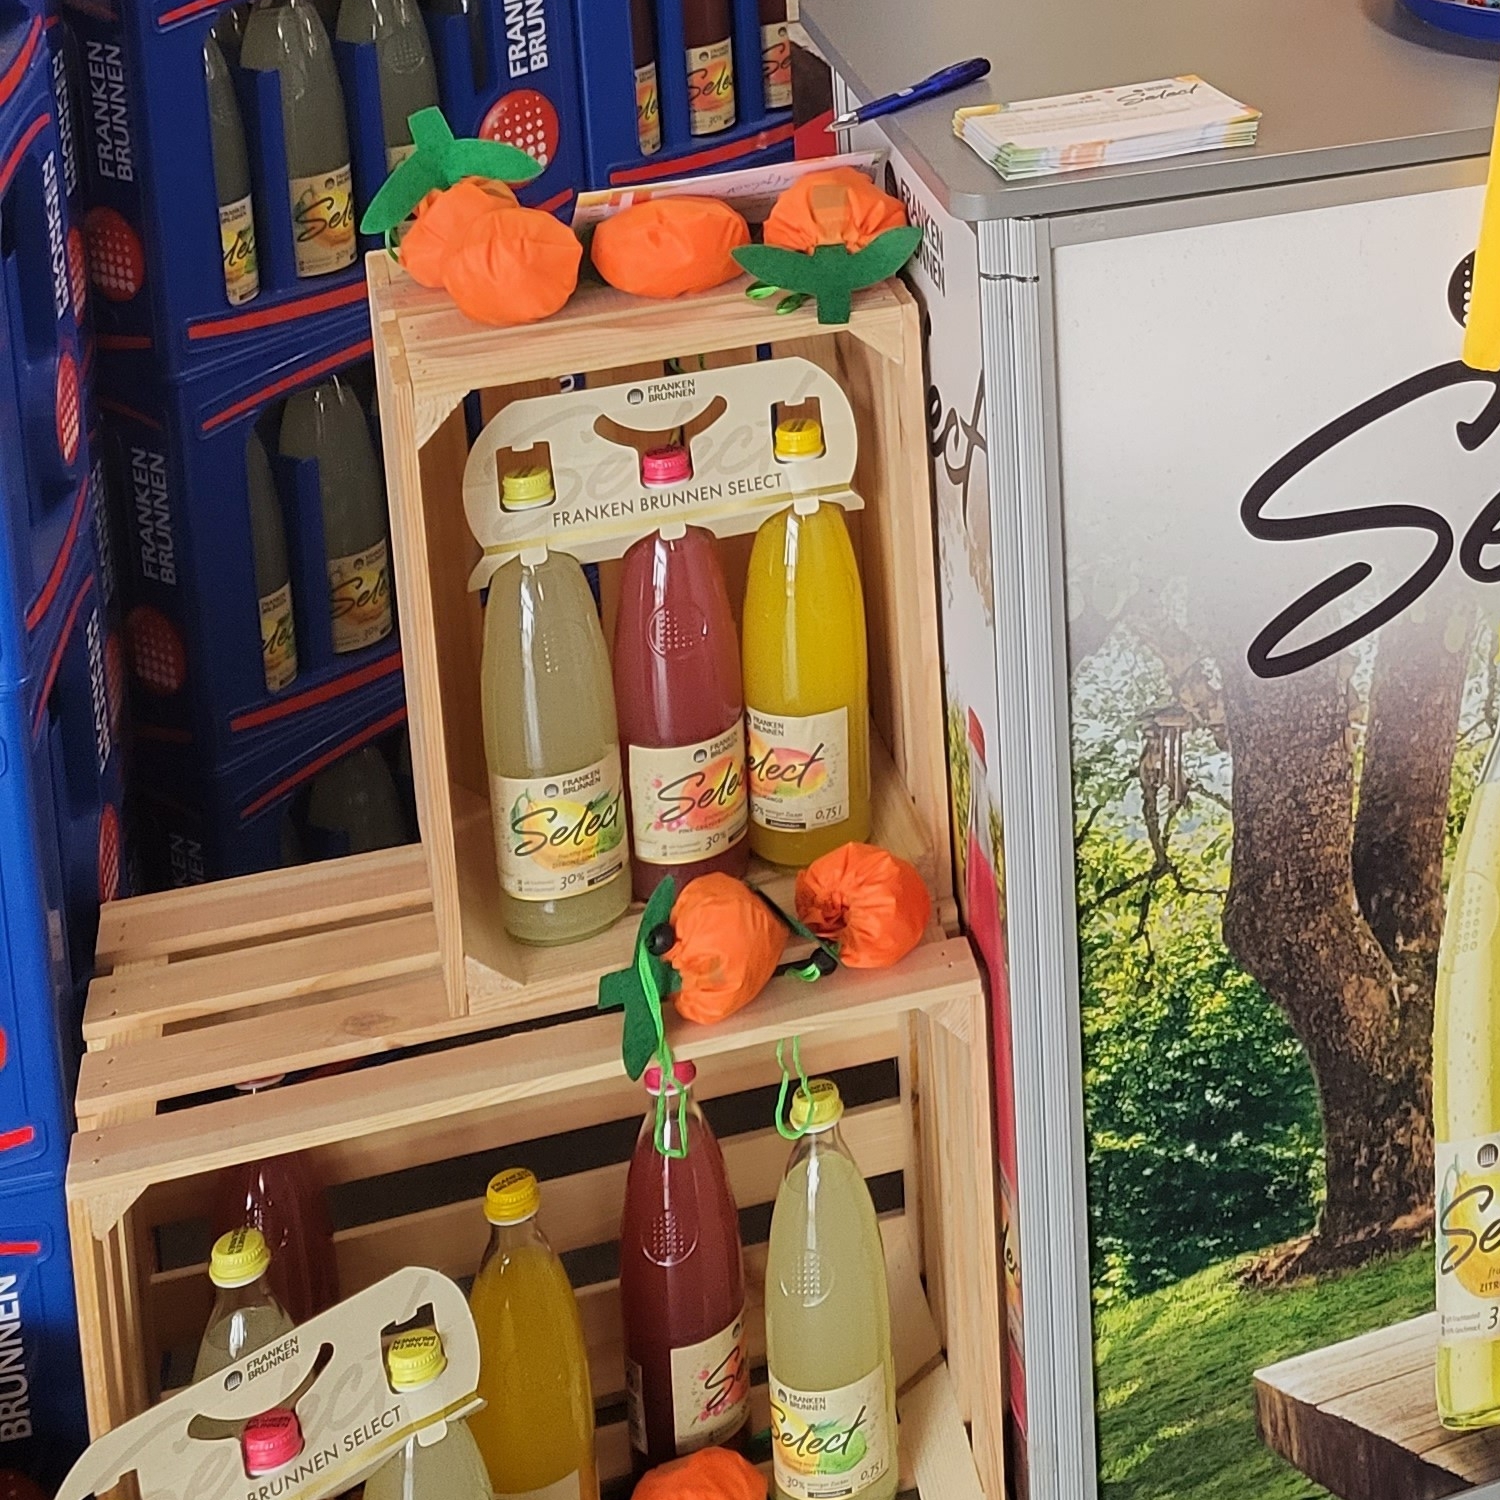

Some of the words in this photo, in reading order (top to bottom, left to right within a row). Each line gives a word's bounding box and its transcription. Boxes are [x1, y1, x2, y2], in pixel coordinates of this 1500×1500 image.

[87, 41, 115, 179] FRANKEN
[104, 44, 133, 182] BRUNNEN
[647, 378, 695, 393] FRANKEN
[648, 387, 696, 403] BRUNNEN
[132, 446, 158, 581] FRANKEN
[148, 452, 176, 585] BRUNNEN
[553, 499, 634, 527] FRANKEN
[639, 486, 723, 512] BRUNNEN
[728, 472, 782, 495] SELECT
[562, 769, 600, 788] FRANKEN
[563, 777, 601, 795] BRUNNEN
[747, 742, 825, 788] elect
[511, 789, 622, 856] Select
[560, 873, 584, 890] 30%
[0, 1274, 32, 1442] BRUNNEN
[246, 1336, 298, 1371] FRANKEN
[247, 1344, 299, 1382] BRUNNEN
[789, 1393, 826, 1404] FRANKEN
[247, 1444, 338, 1500] BRUNNEN
[343, 1405, 401, 1452] SELECT
[770, 1404, 867, 1458] Select
[786, 1476, 805, 1490] 30%
